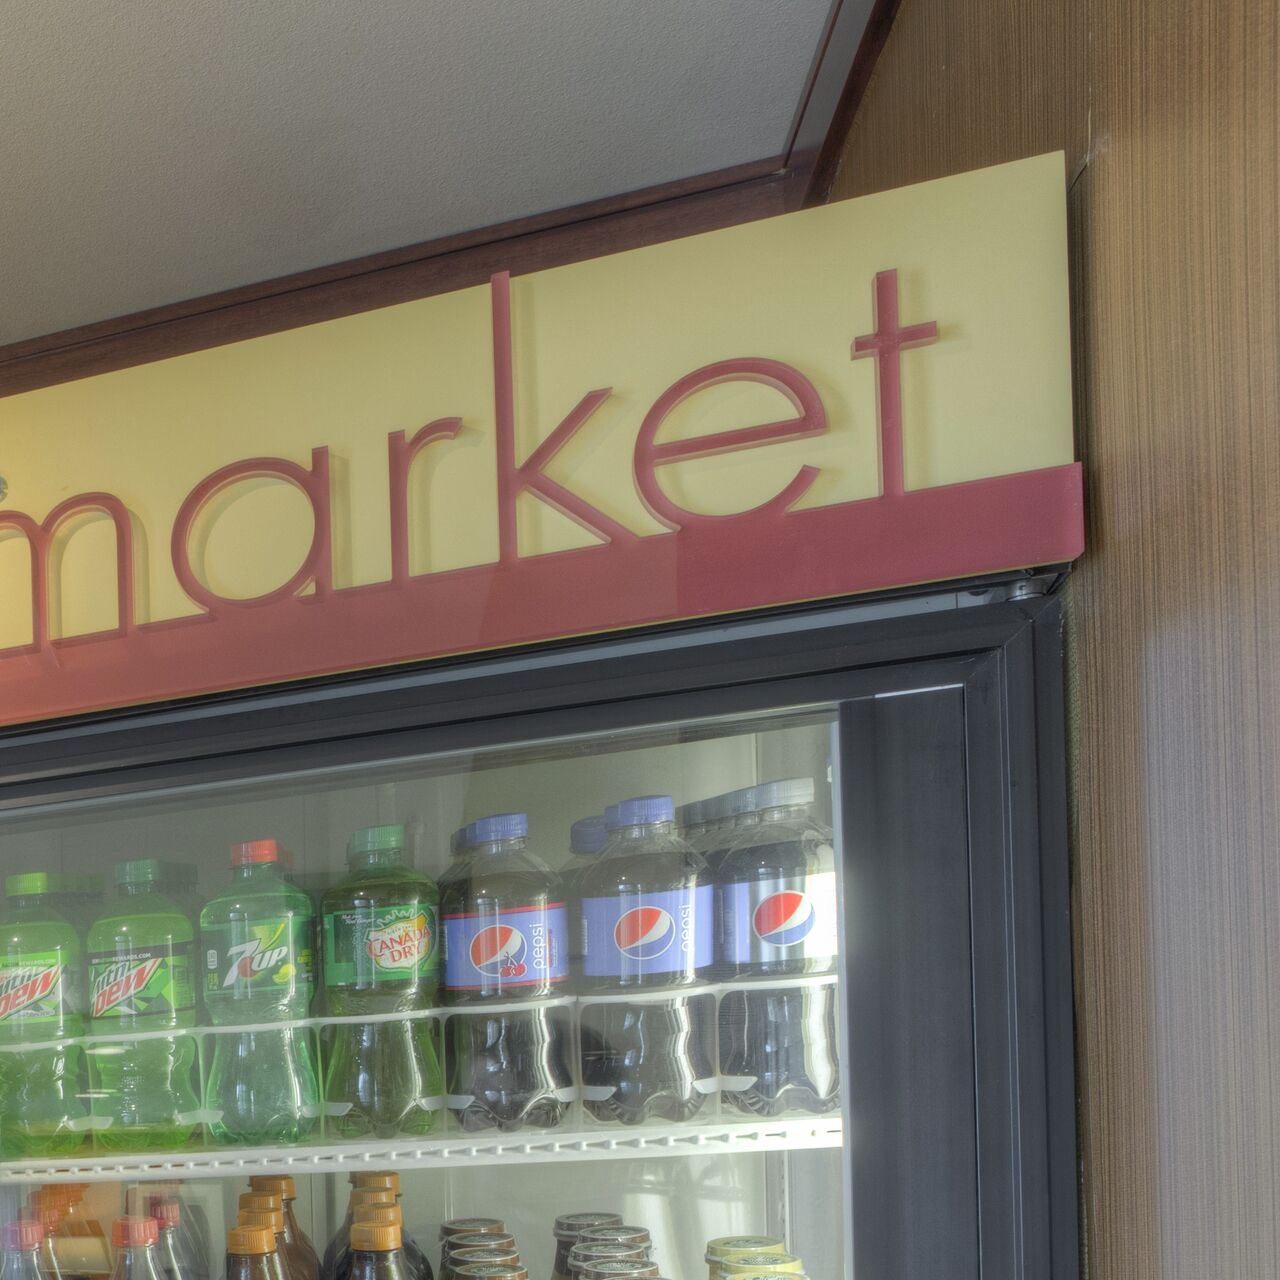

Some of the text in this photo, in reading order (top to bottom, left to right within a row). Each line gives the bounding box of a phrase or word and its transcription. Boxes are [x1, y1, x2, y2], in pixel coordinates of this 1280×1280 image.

[368, 926, 431, 957] CANADA
[532, 920, 545, 970] pepsi
[680, 903, 692, 953] pepsi
[390, 944, 422, 963] DRY
